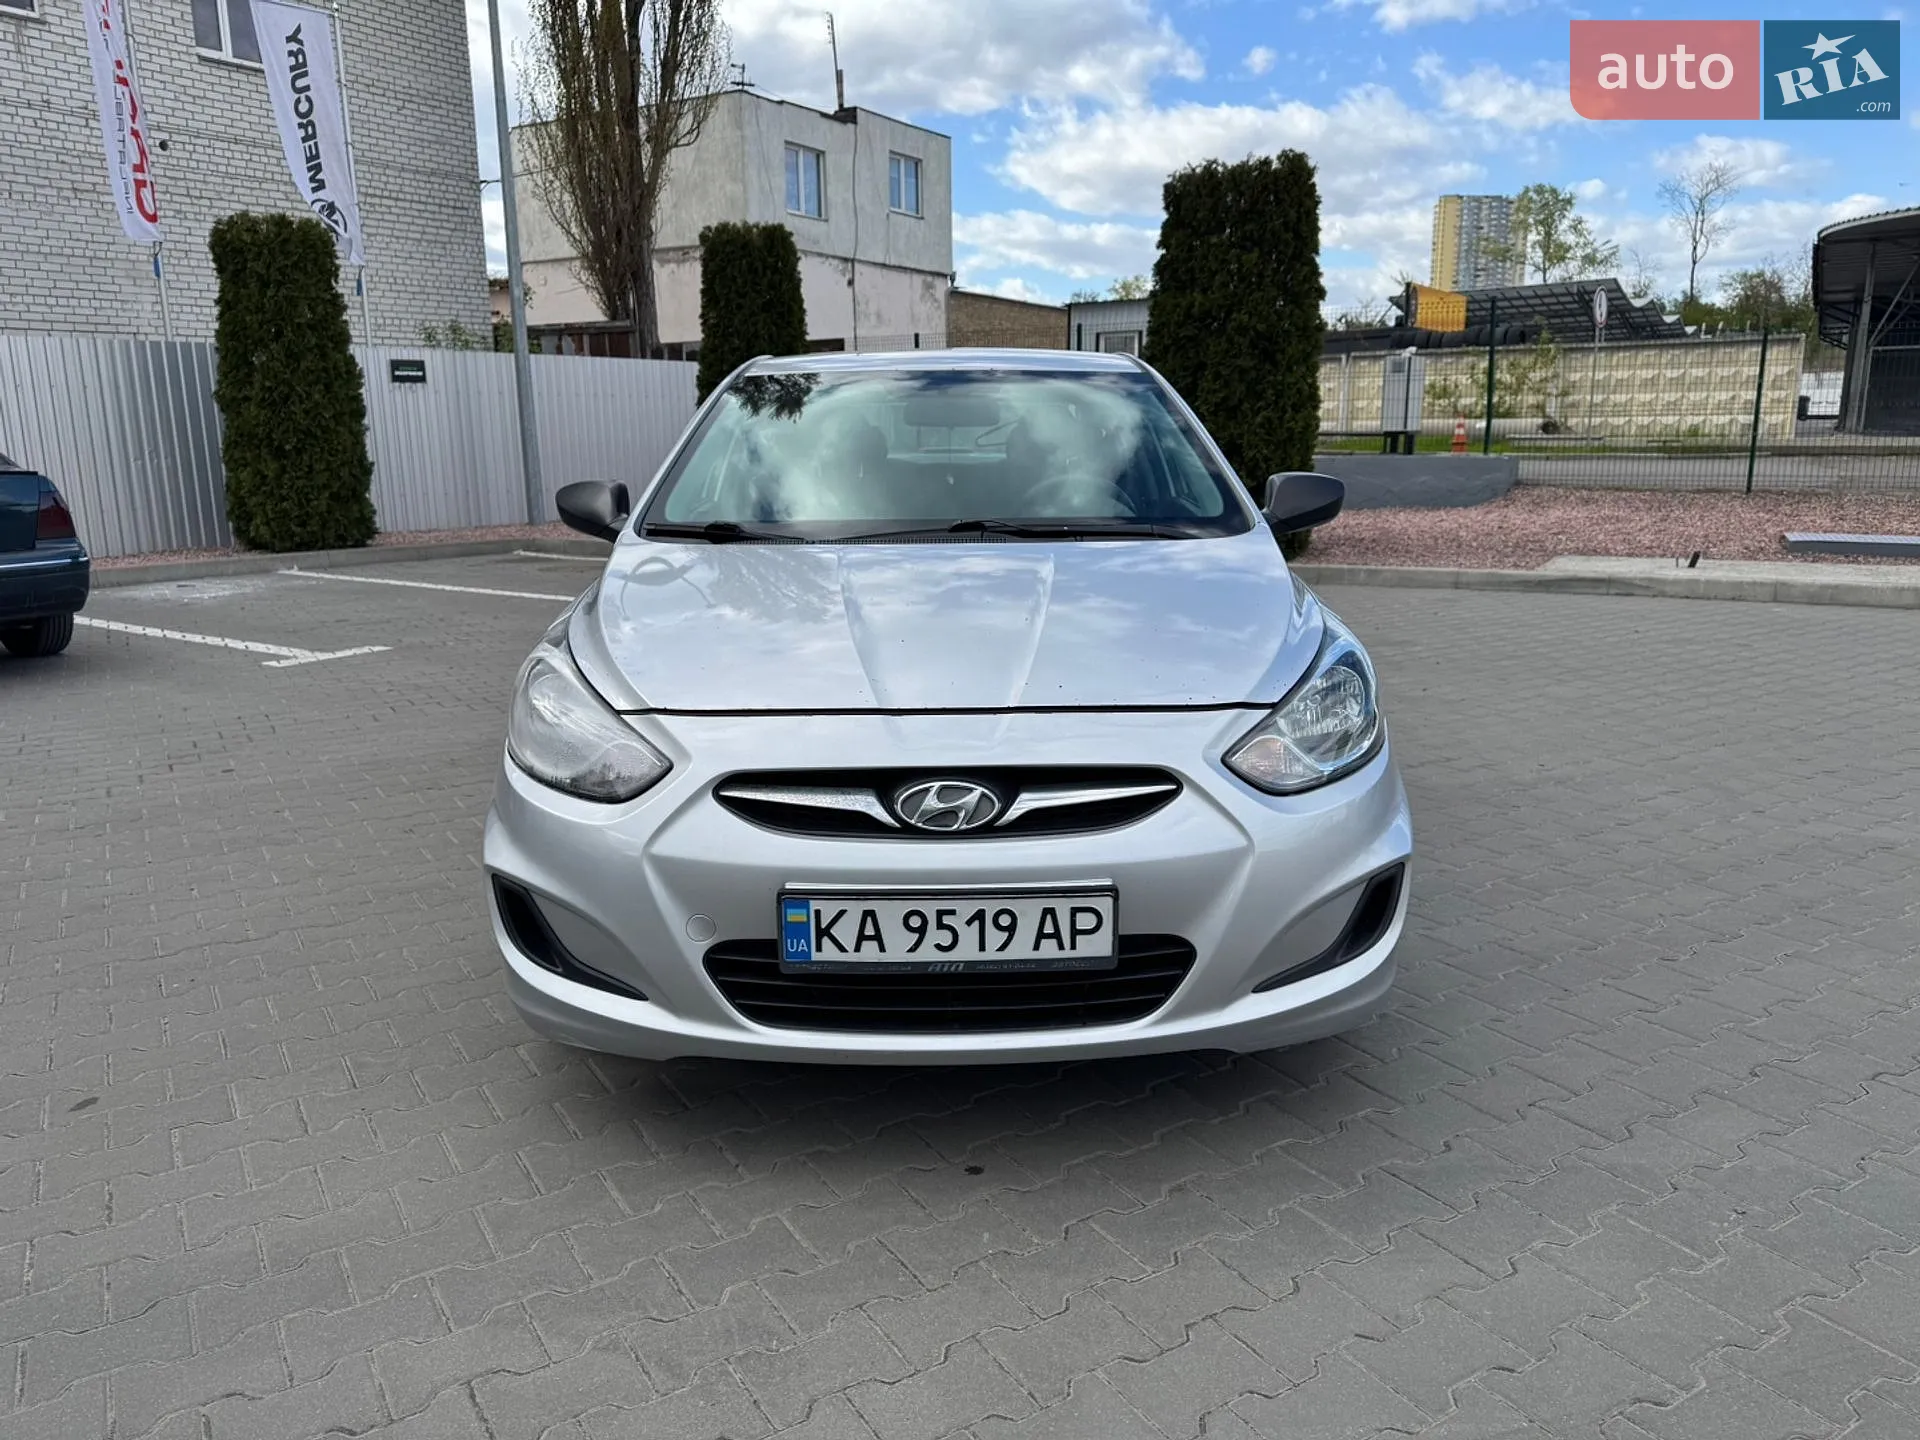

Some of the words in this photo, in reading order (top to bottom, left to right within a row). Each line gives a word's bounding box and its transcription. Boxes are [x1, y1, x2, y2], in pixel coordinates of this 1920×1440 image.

[787, 938, 809, 953] UA
[813, 908, 887, 954] KA
[902, 908, 1018, 954] 9519
[1032, 906, 1104, 952] AP
